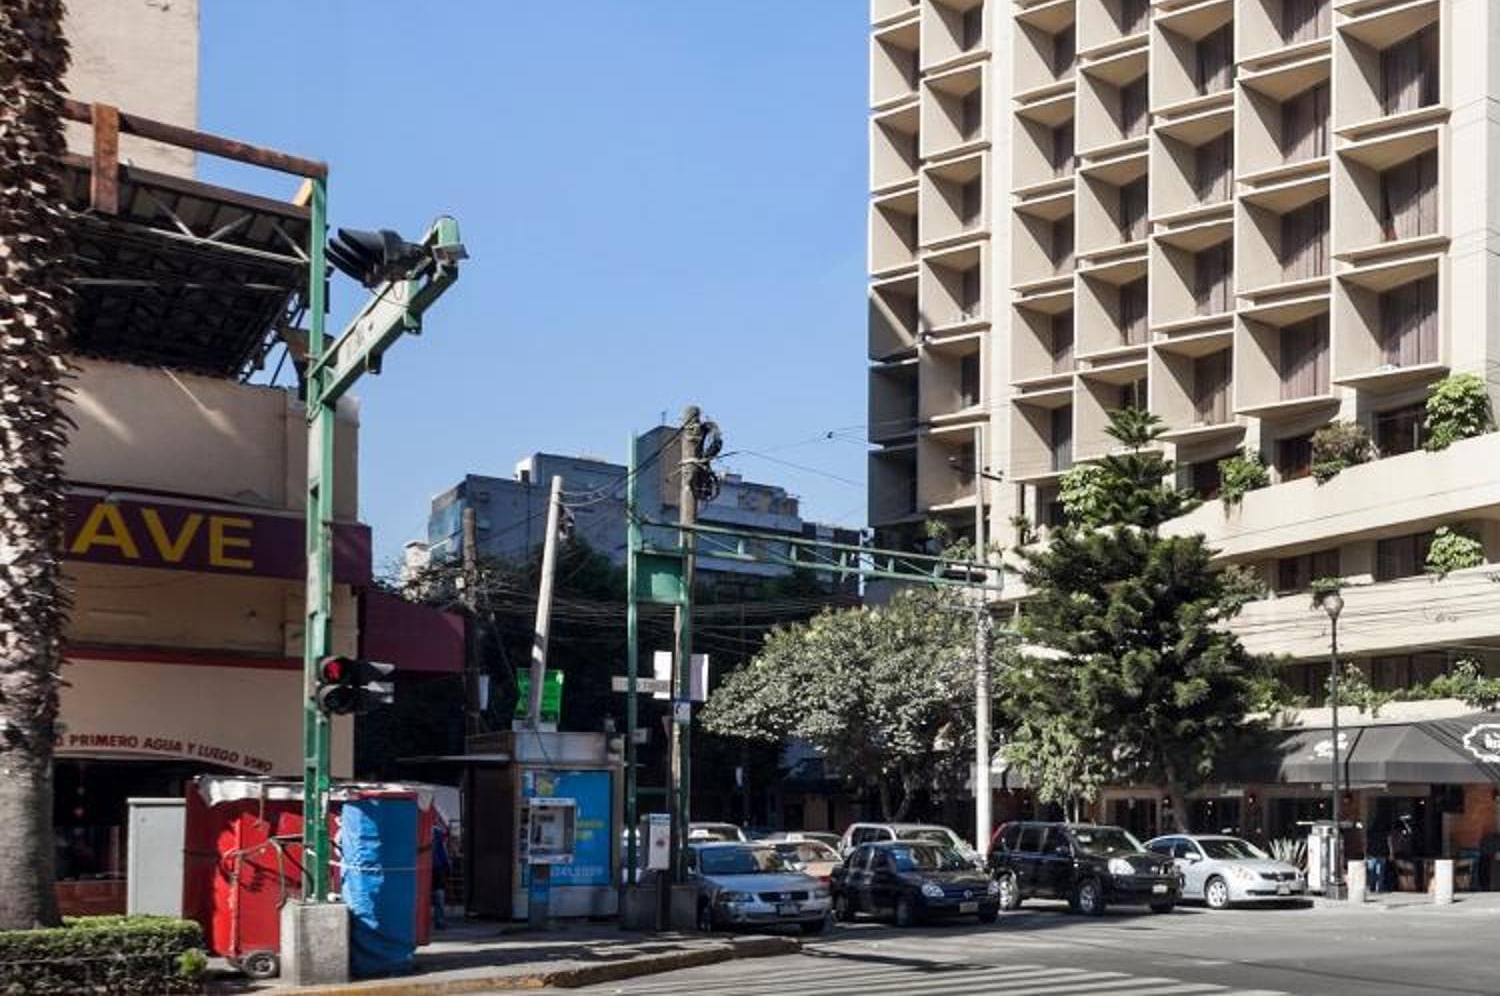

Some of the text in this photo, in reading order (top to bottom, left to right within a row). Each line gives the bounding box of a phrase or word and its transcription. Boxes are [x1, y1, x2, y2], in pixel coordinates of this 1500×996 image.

[69, 733, 139, 748] PRIMERO
[143, 737, 182, 752] AGUA
[187, 742, 197, 755] Y
[197, 745, 239, 764] LUEGO
